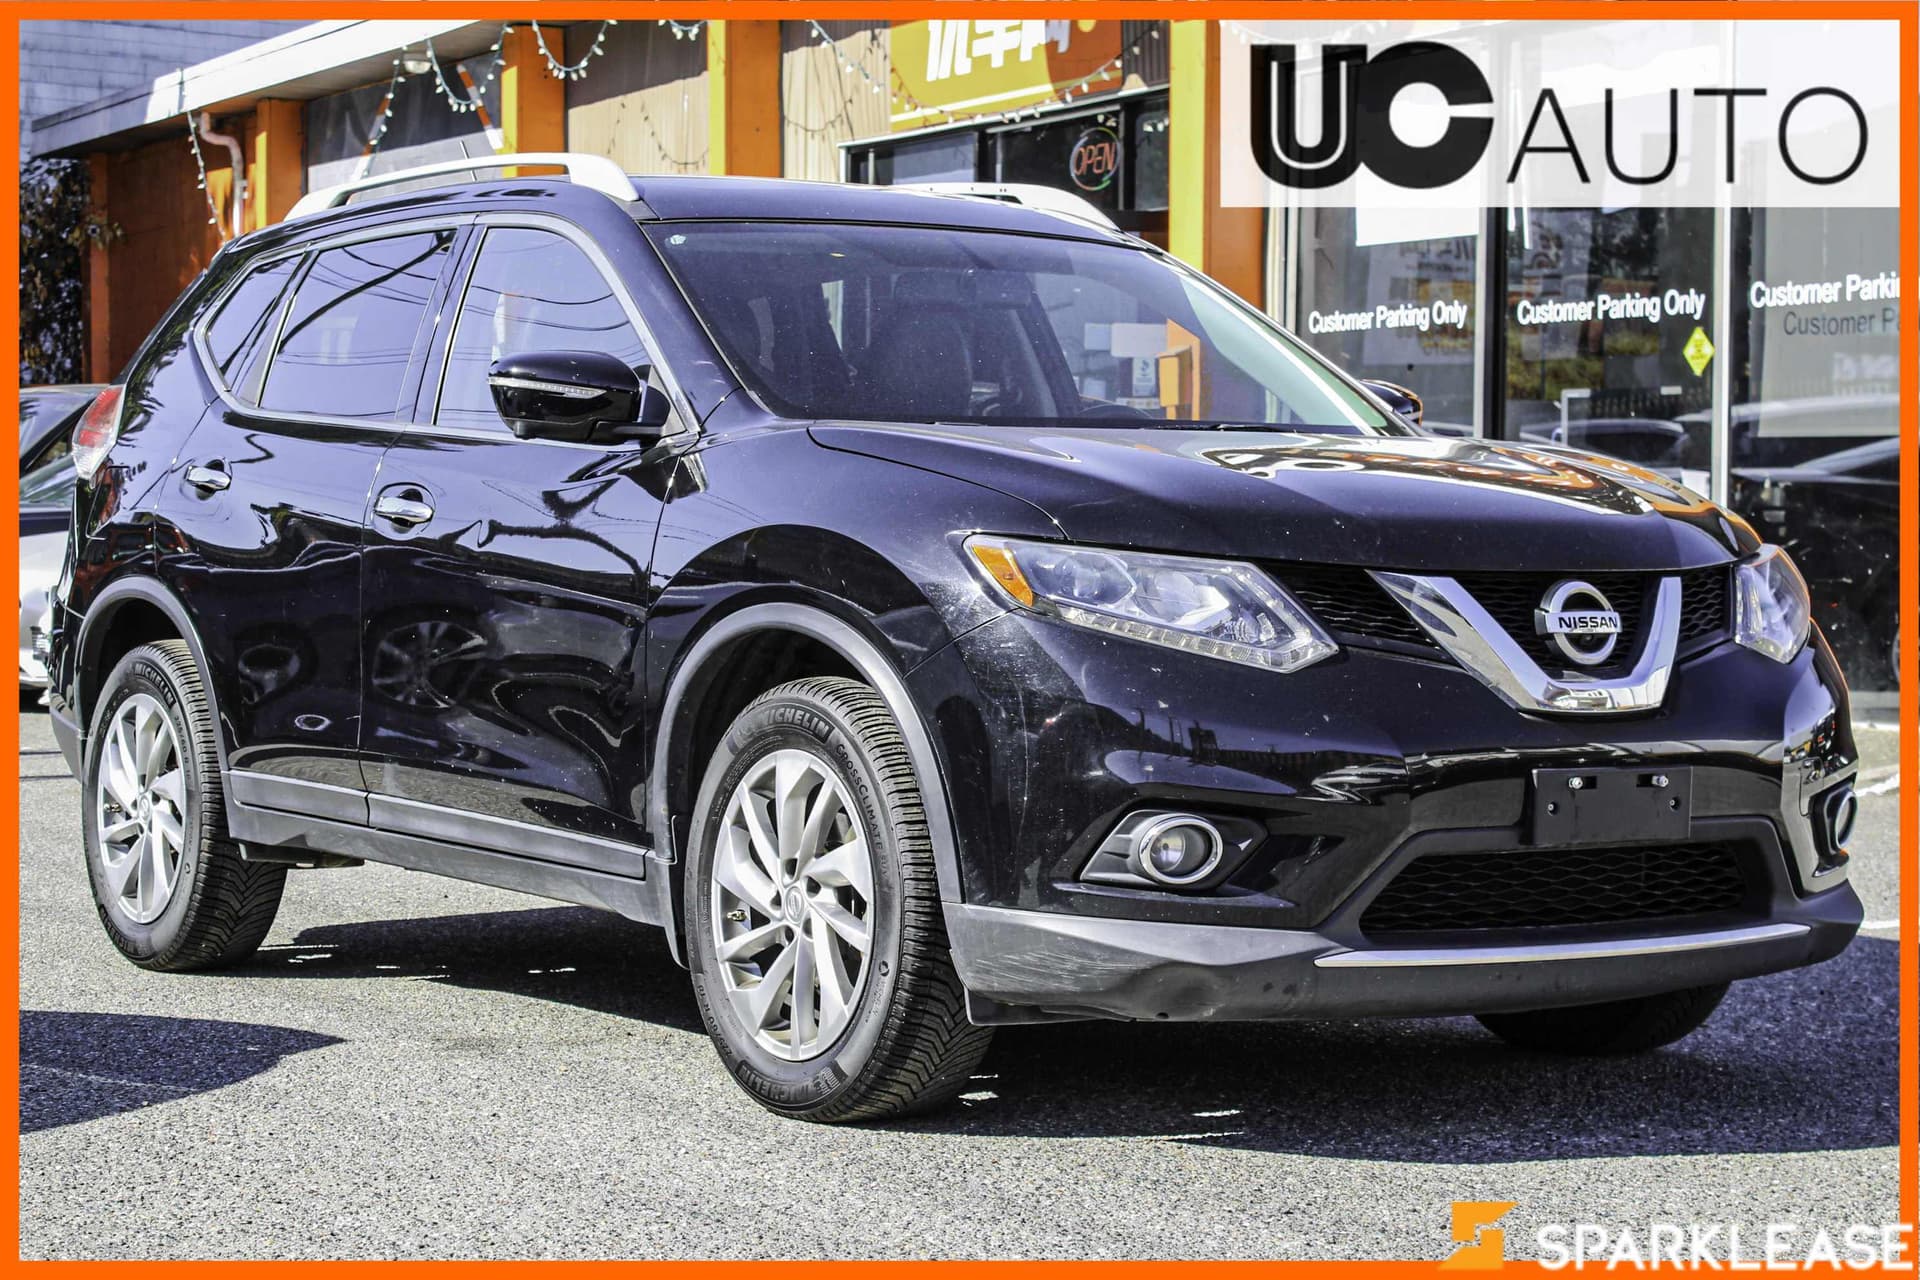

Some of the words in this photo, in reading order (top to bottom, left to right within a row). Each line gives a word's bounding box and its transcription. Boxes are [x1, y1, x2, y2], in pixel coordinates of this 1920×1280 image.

[1073, 143, 1116, 176] OPEN
[1517, 300, 1595, 325] Customer
[1597, 292, 1661, 323] Parking
[1664, 288, 1706, 320] Only
[1751, 280, 1842, 308] Customer
[1308, 310, 1374, 334] Customer
[1376, 304, 1430, 331] Parking
[1432, 300, 1468, 330] Only
[1783, 311, 1875, 336] Customer
[1881, 307, 1900, 333] P
[1559, 616, 1618, 629] NISSAN
[134, 662, 176, 706] MICHELIN
[758, 707, 830, 739] MICHELIN
